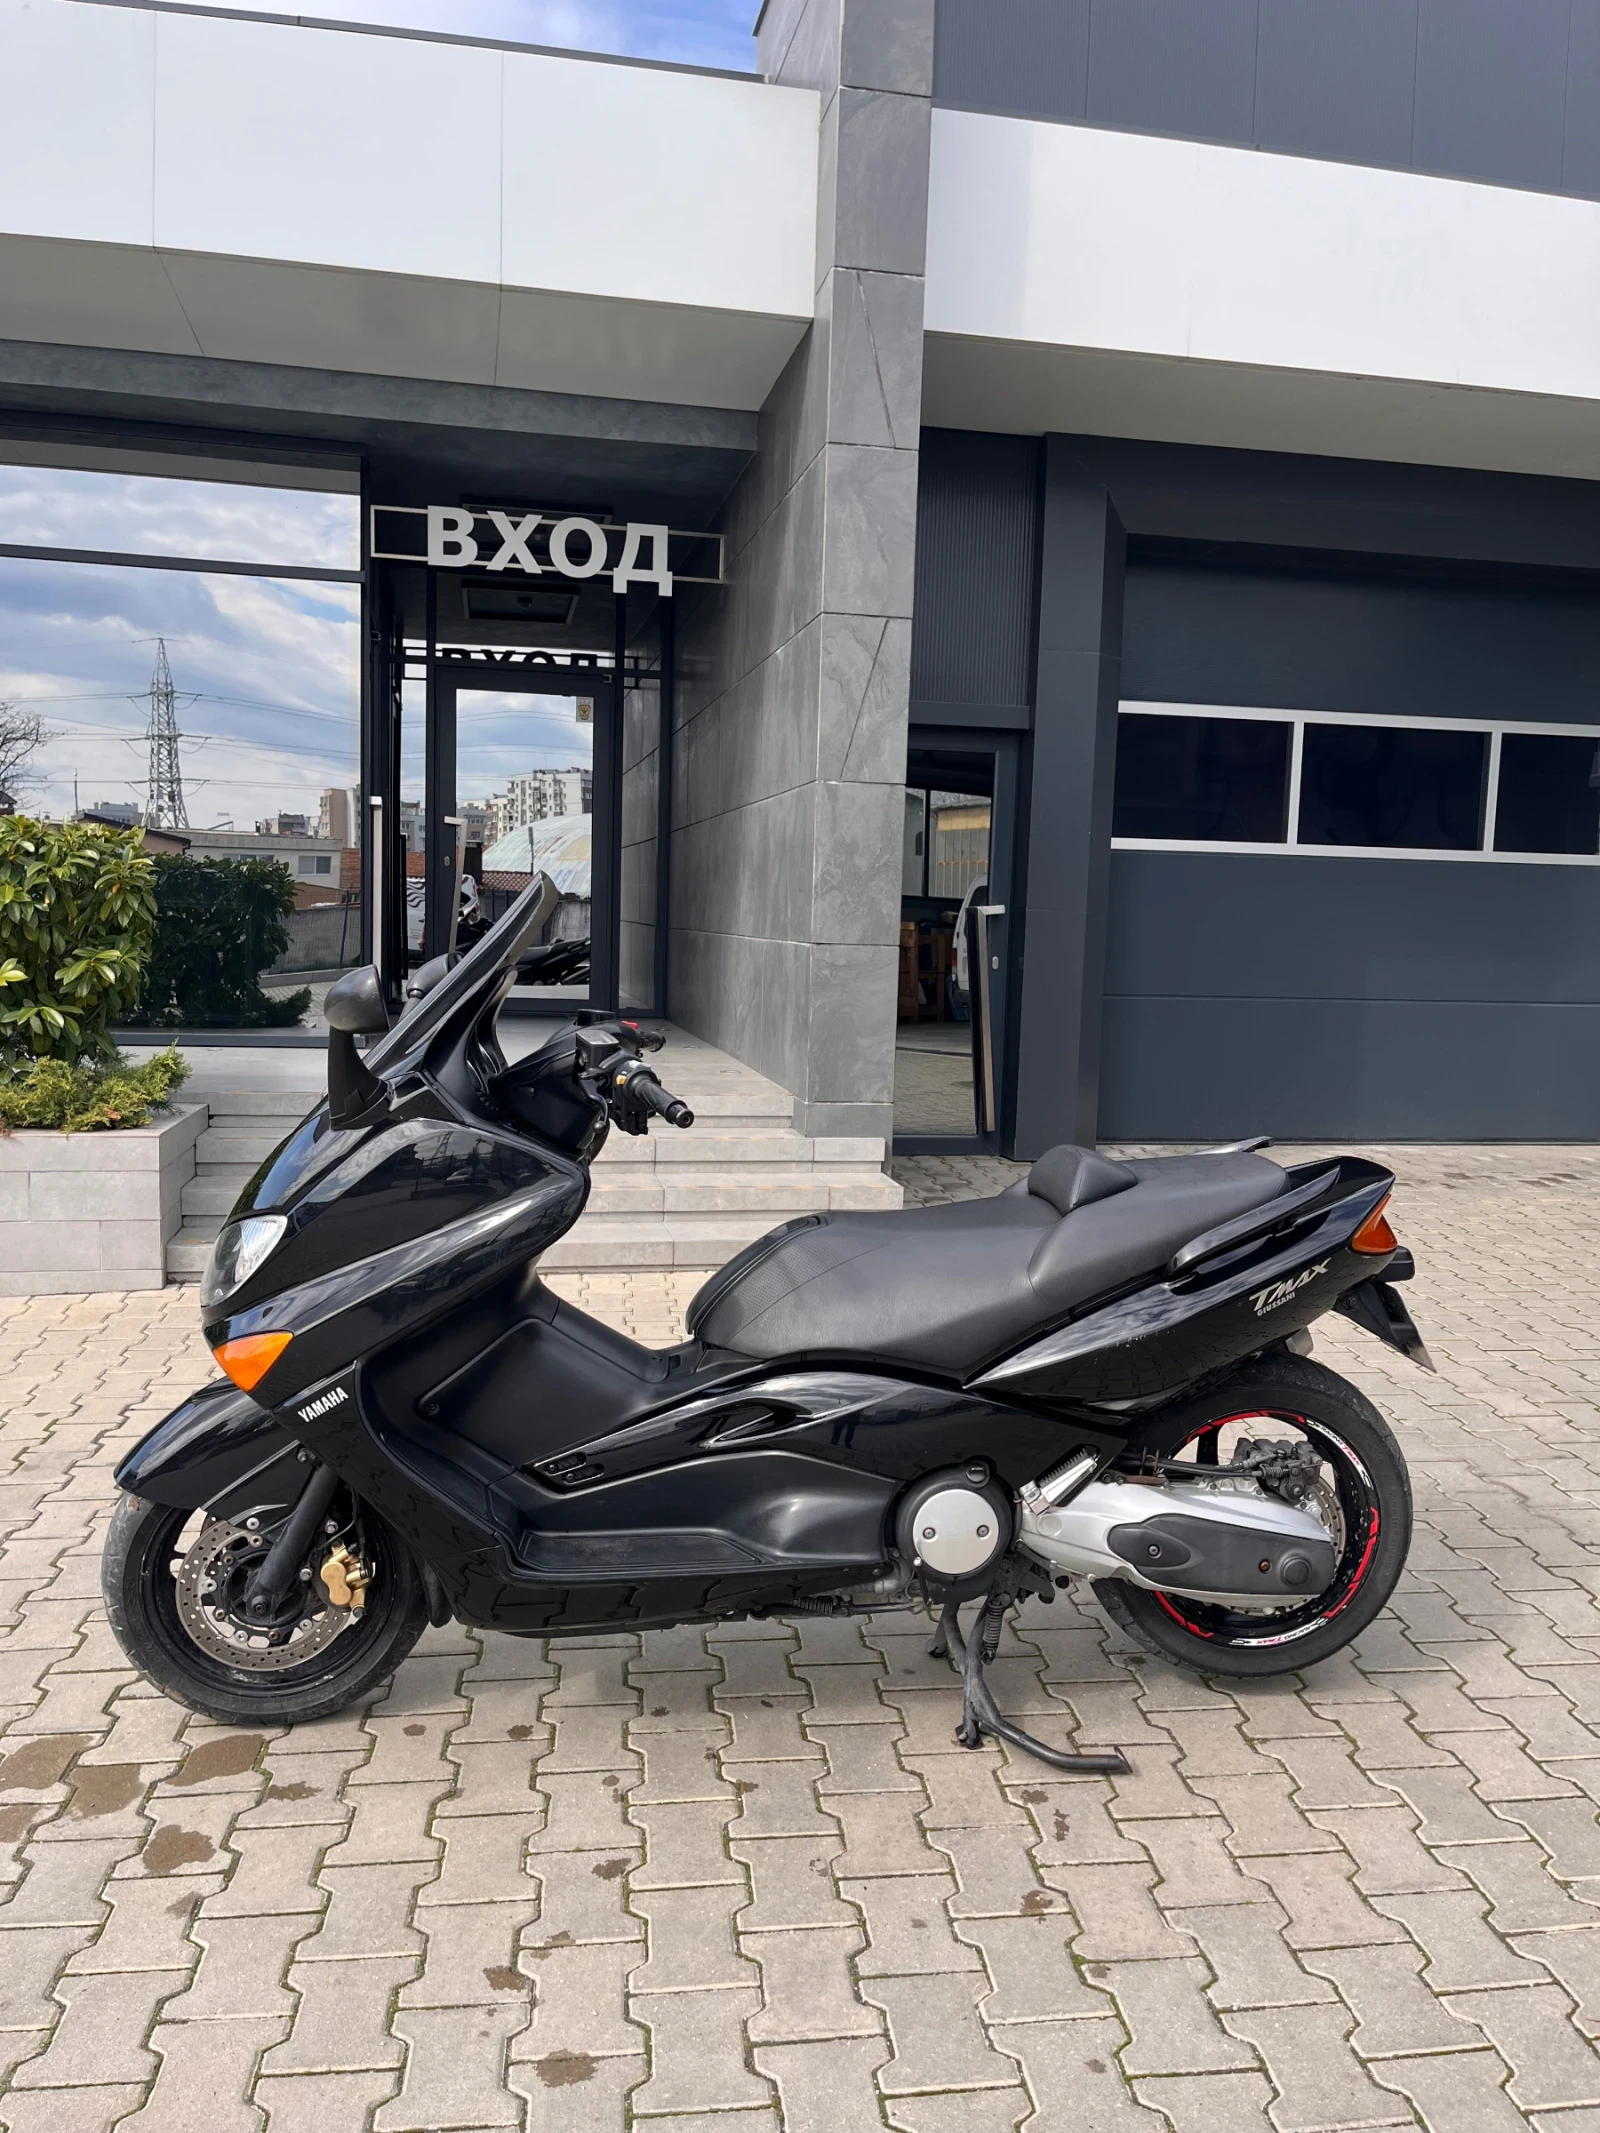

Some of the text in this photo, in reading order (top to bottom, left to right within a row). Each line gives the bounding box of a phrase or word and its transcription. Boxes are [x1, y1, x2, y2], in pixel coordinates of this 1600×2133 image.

[427, 505, 673, 597] ВХОД
[1256, 1291, 1296, 1317] GIUSSANI
[297, 1386, 349, 1423] YAMAHA
